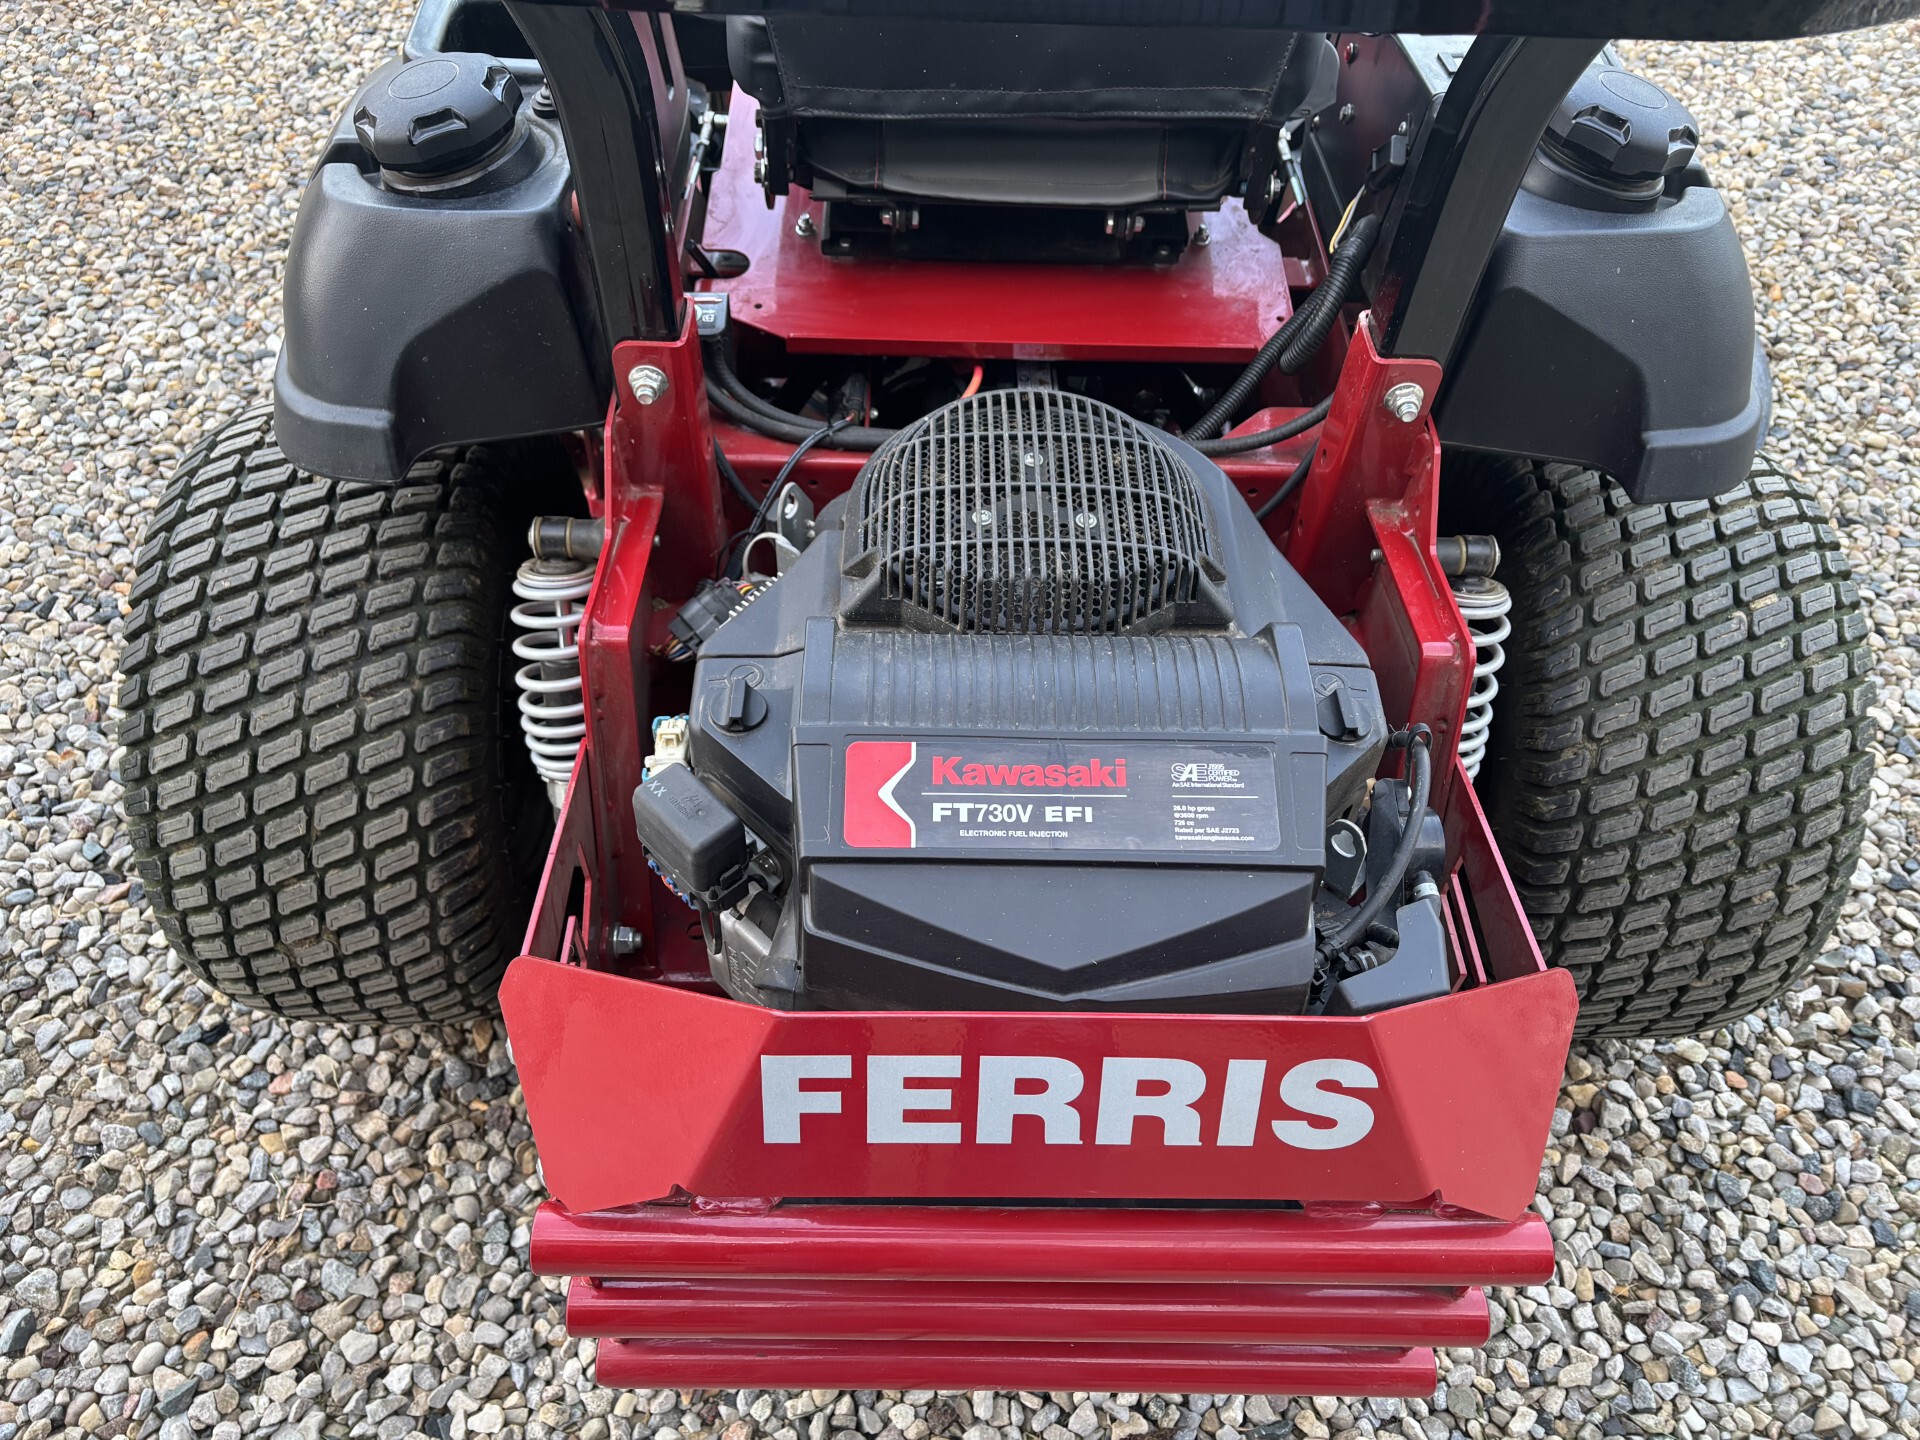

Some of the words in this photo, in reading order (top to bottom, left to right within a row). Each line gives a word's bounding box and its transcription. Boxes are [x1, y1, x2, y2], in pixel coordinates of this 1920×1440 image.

[932, 756, 1127, 788] Kawasaki
[1171, 763, 1208, 782] SAE
[932, 802, 1034, 823] FT730V
[1044, 806, 1093, 823] EFI
[1187, 805, 1196, 813] hp
[959, 829, 1007, 837] ELECTRONIC
[1008, 830, 1028, 838] FUEL
[1175, 834, 1255, 842] kawasakienginesusa.com
[761, 1055, 1379, 1150] FERRIS
